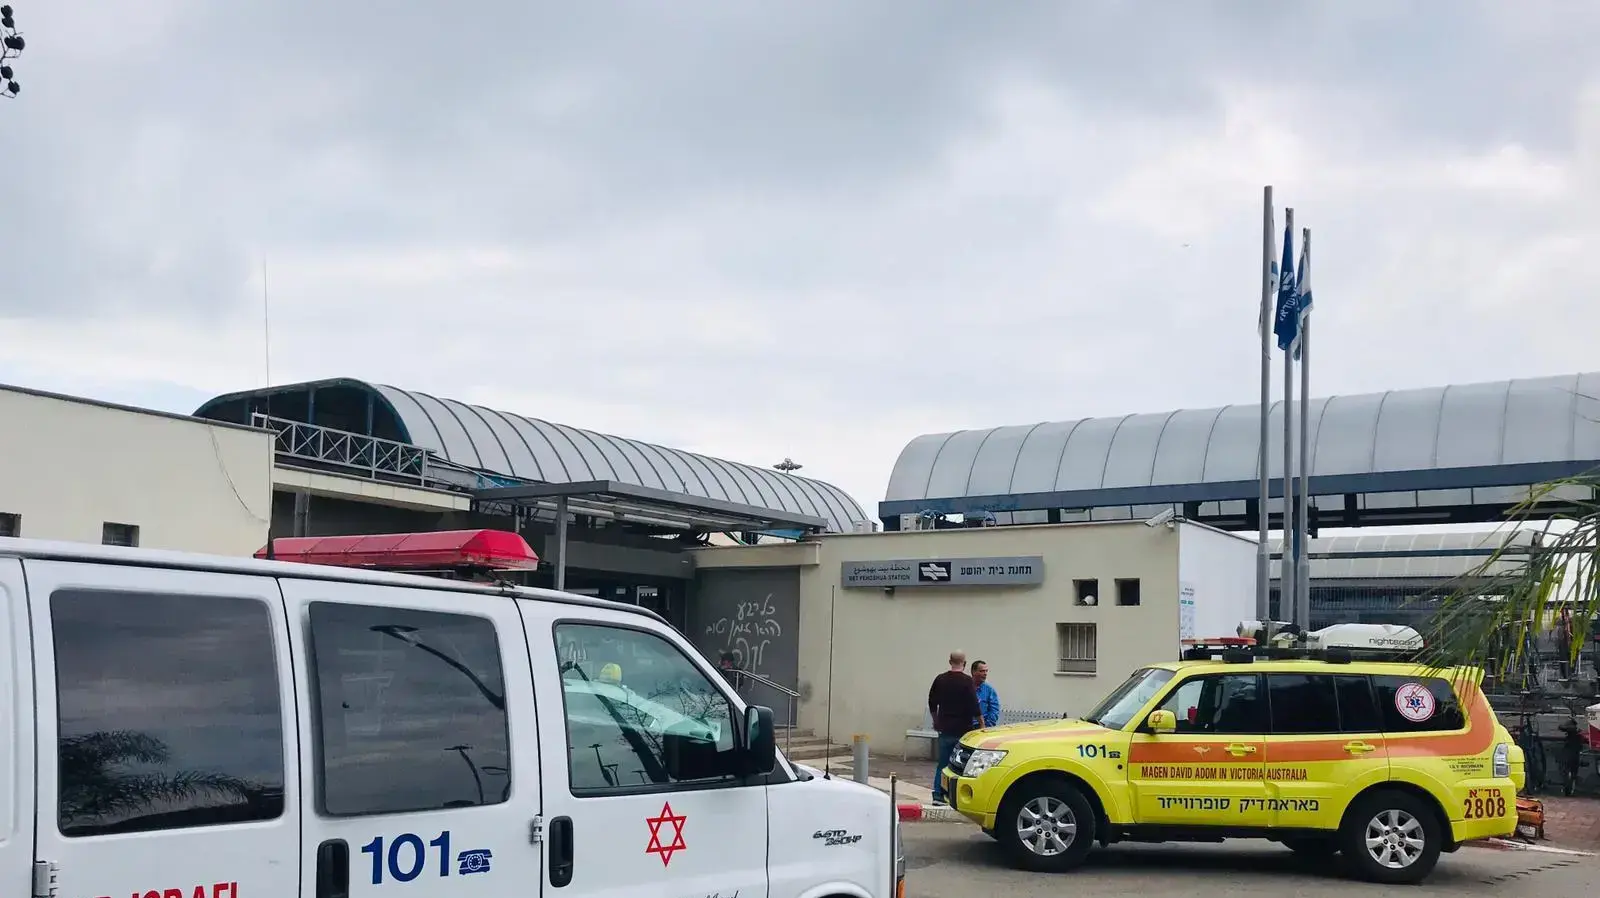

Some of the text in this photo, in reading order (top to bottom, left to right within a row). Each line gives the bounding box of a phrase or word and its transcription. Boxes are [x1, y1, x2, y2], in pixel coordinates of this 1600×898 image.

[960, 565, 1032, 576] תחנת בית יהושע
[760, 593, 776, 616] כל
[705, 617, 728, 635] טוב
[1076, 744, 1107, 757] 101
[1141, 766, 1308, 780] MAGEN DAVID ADOM IN VICTORIA AUSTRALIA
[1157, 797, 1320, 813] פאראמדיק סופרווייזר
[1463, 797, 1506, 819] 2808
[361, 830, 450, 885] 101
